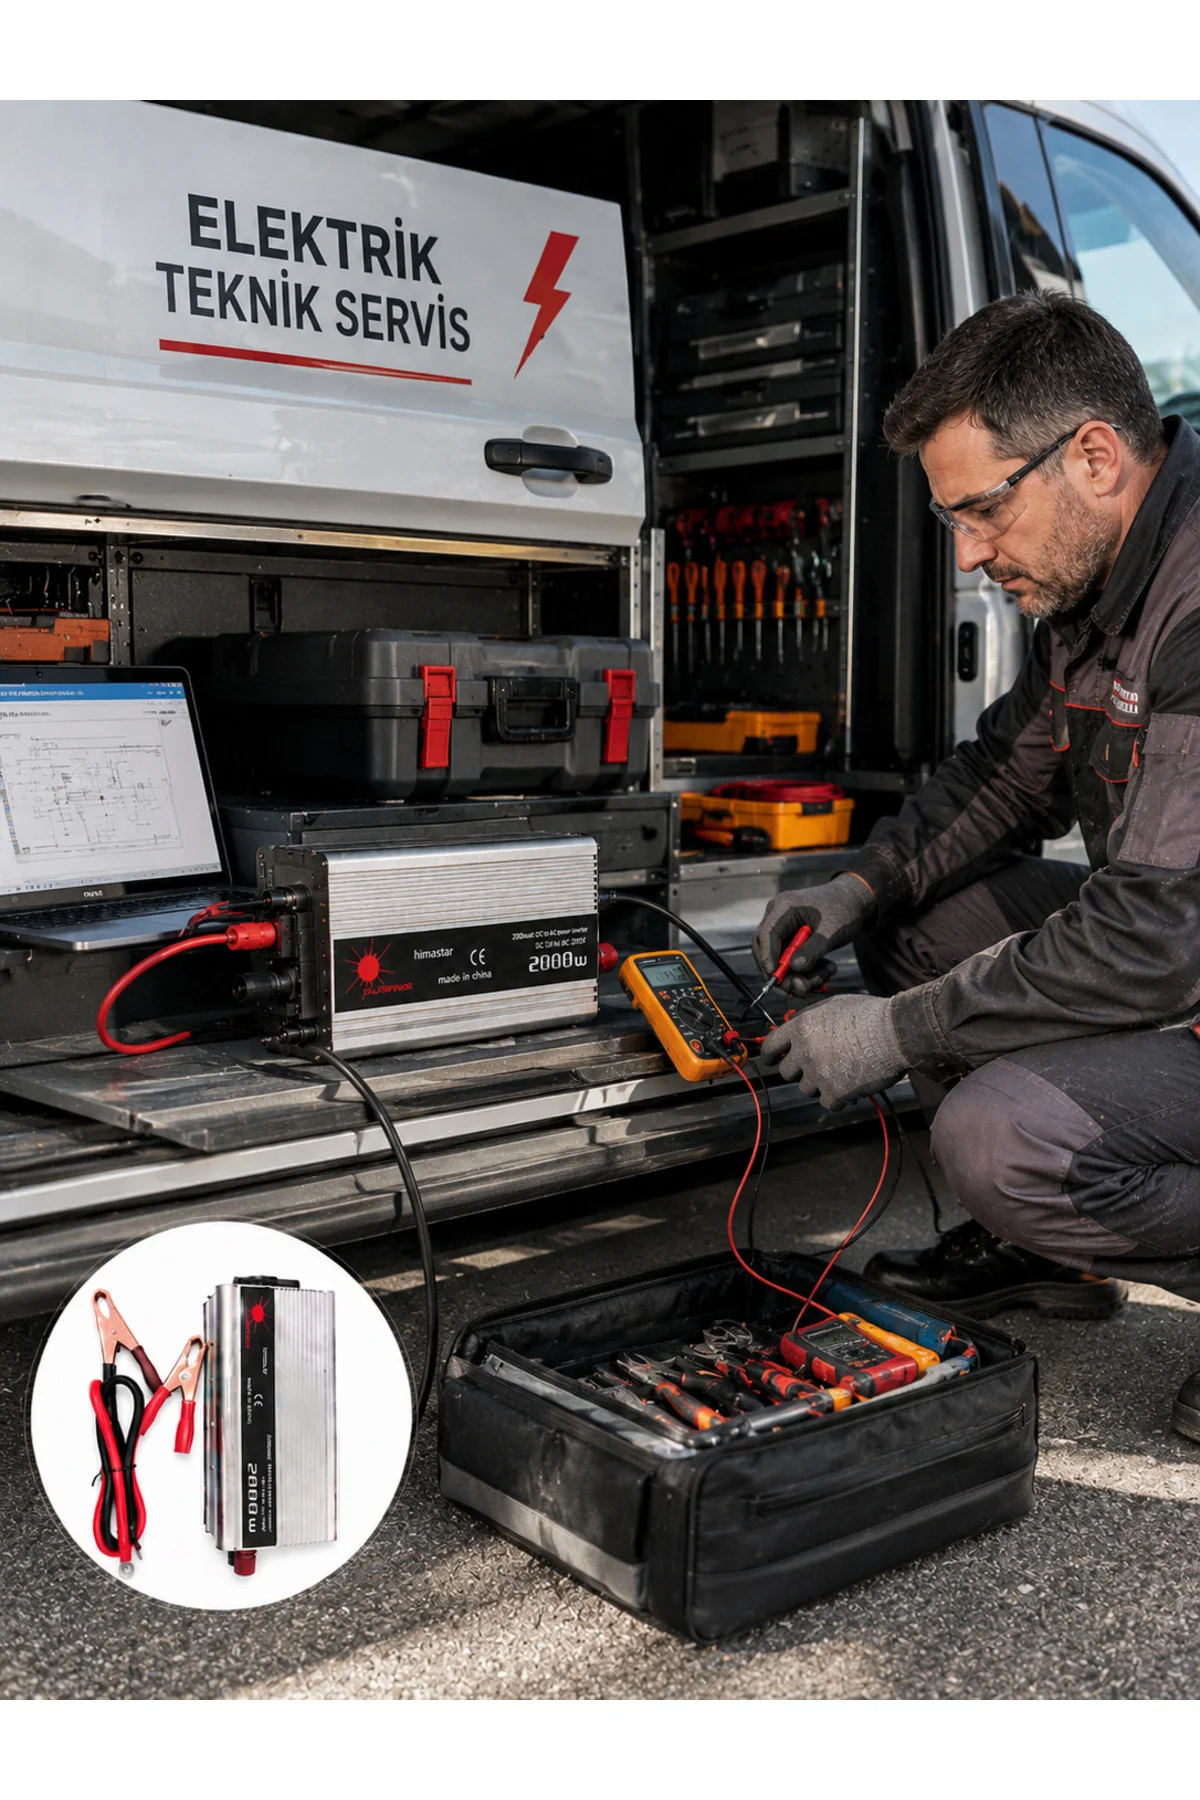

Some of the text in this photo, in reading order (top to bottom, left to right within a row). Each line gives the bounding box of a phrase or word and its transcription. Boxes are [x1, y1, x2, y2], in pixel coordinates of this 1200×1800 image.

[187, 193, 442, 286] ELEKTRİK
[155, 261, 471, 353] TEKNİK SERVİS
[413, 947, 454, 960] himastar
[470, 948, 486, 966] CE
[438, 970, 492, 984] made in china
